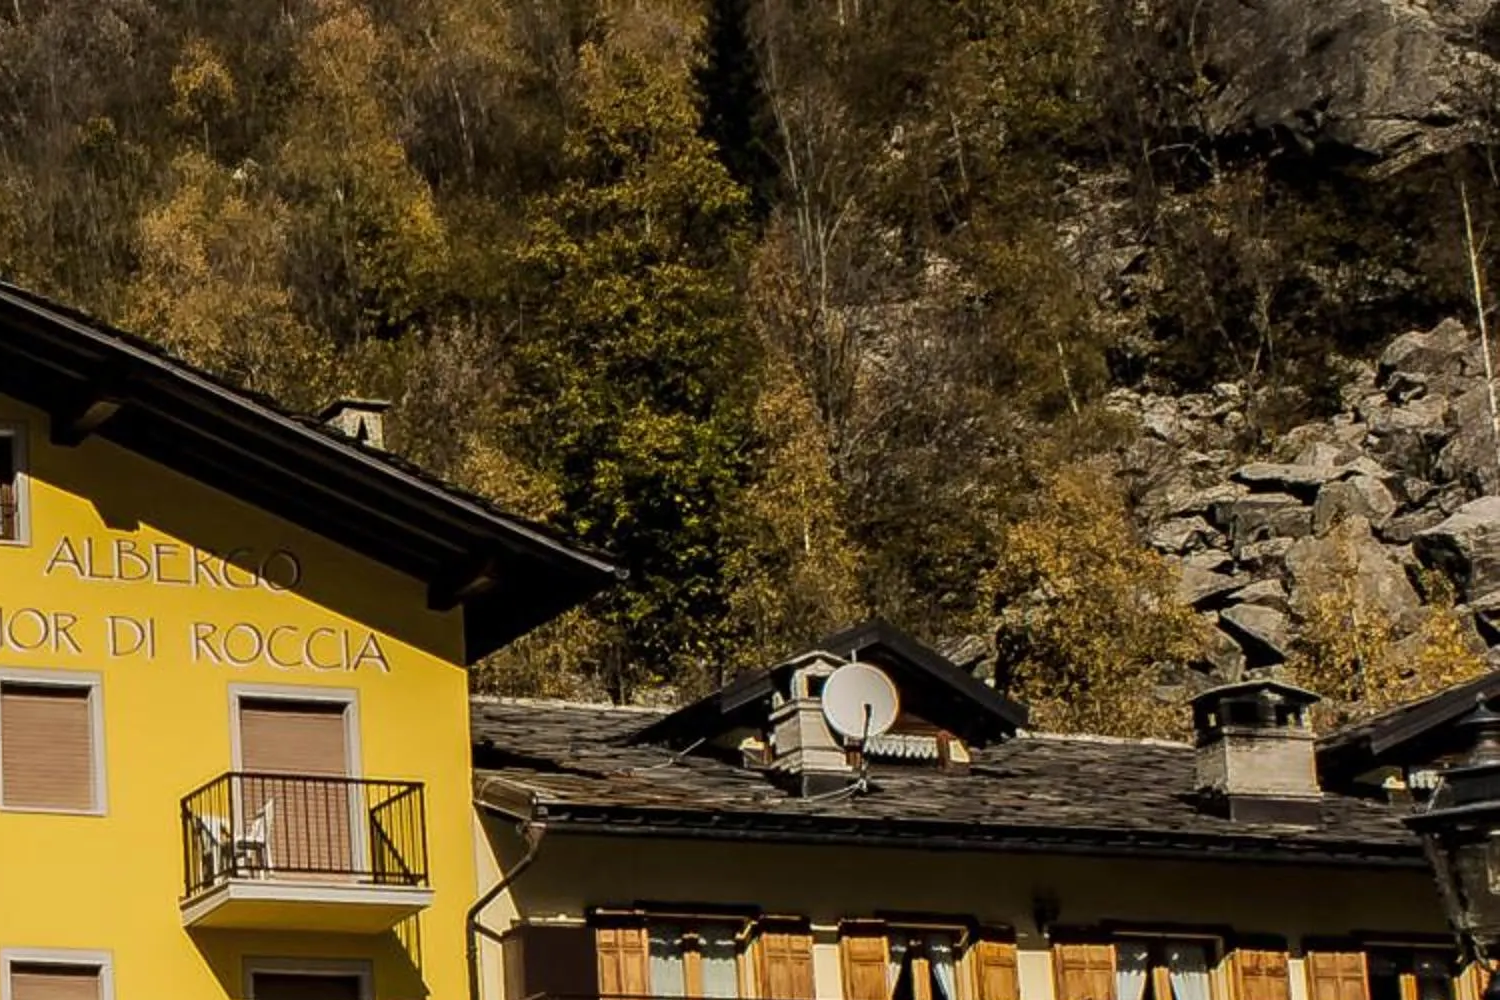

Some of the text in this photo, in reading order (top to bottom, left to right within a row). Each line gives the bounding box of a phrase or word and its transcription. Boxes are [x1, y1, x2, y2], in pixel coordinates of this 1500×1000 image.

[44, 536, 300, 591] ALBERGO
[106, 615, 155, 660] DI
[190, 622, 391, 673] ROCCIA
